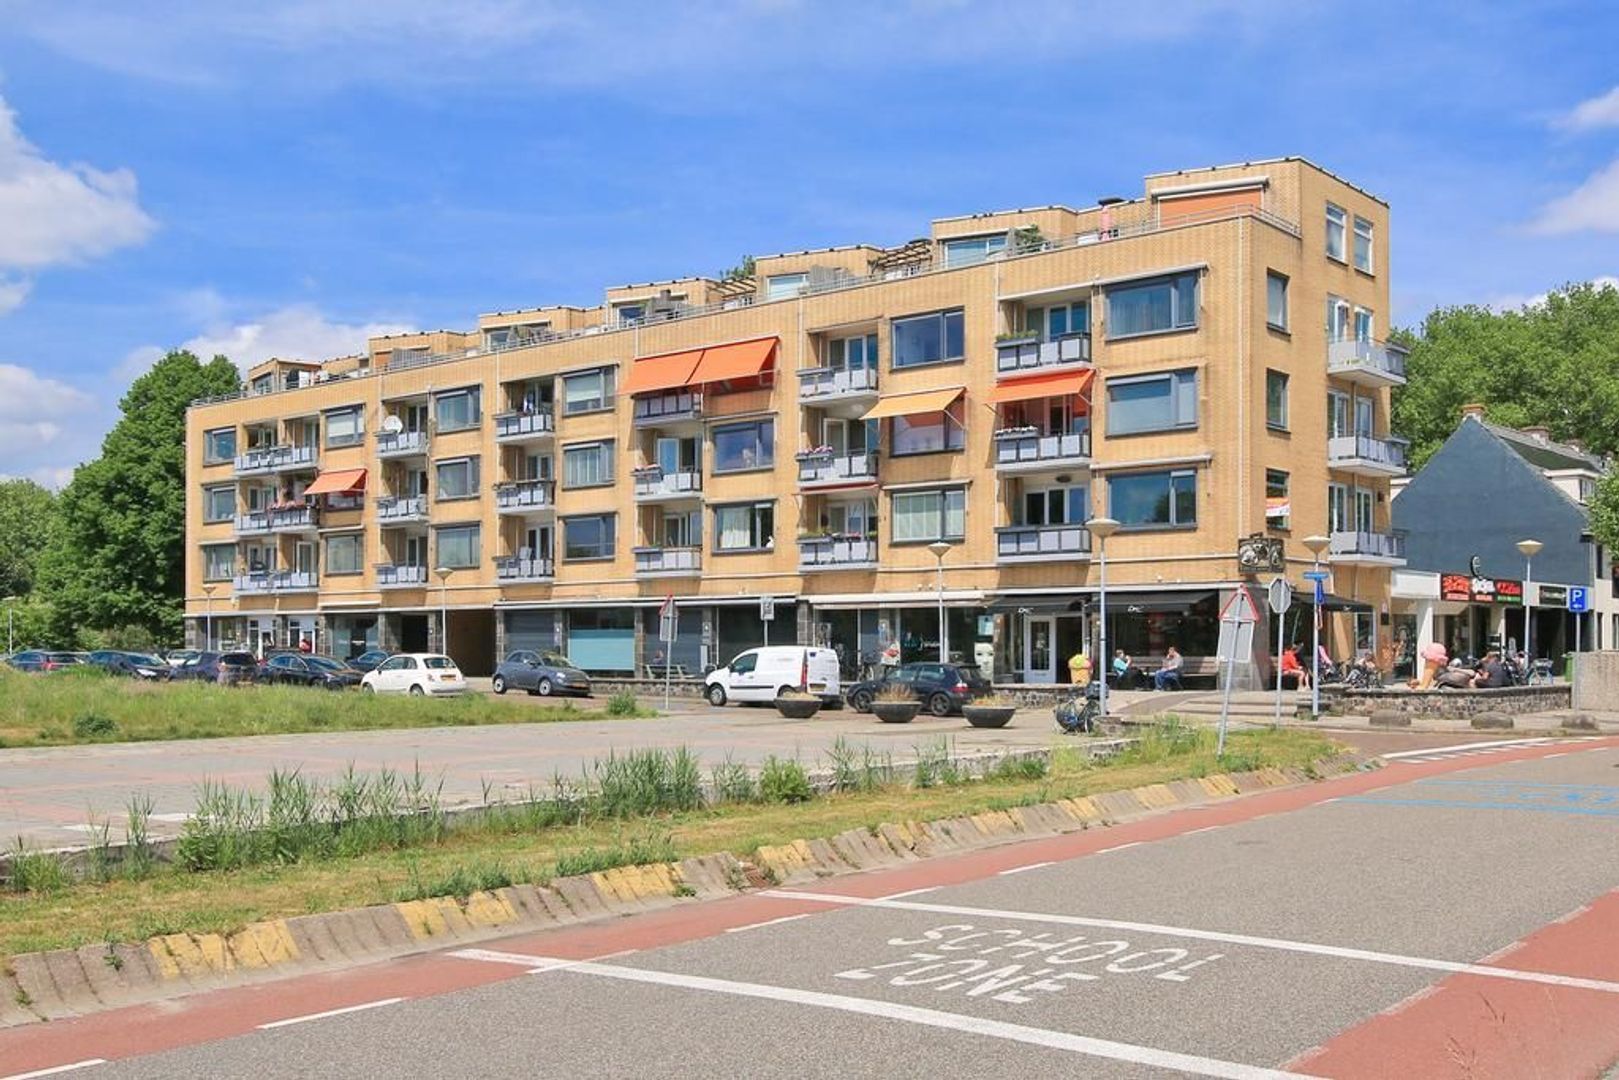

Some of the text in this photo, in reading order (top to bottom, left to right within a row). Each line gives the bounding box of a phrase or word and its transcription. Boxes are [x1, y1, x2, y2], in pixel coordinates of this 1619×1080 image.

[1572, 589, 1583, 602] P
[833, 953, 1098, 1004] ZONE
[888, 925, 1225, 982] SCHOOL
